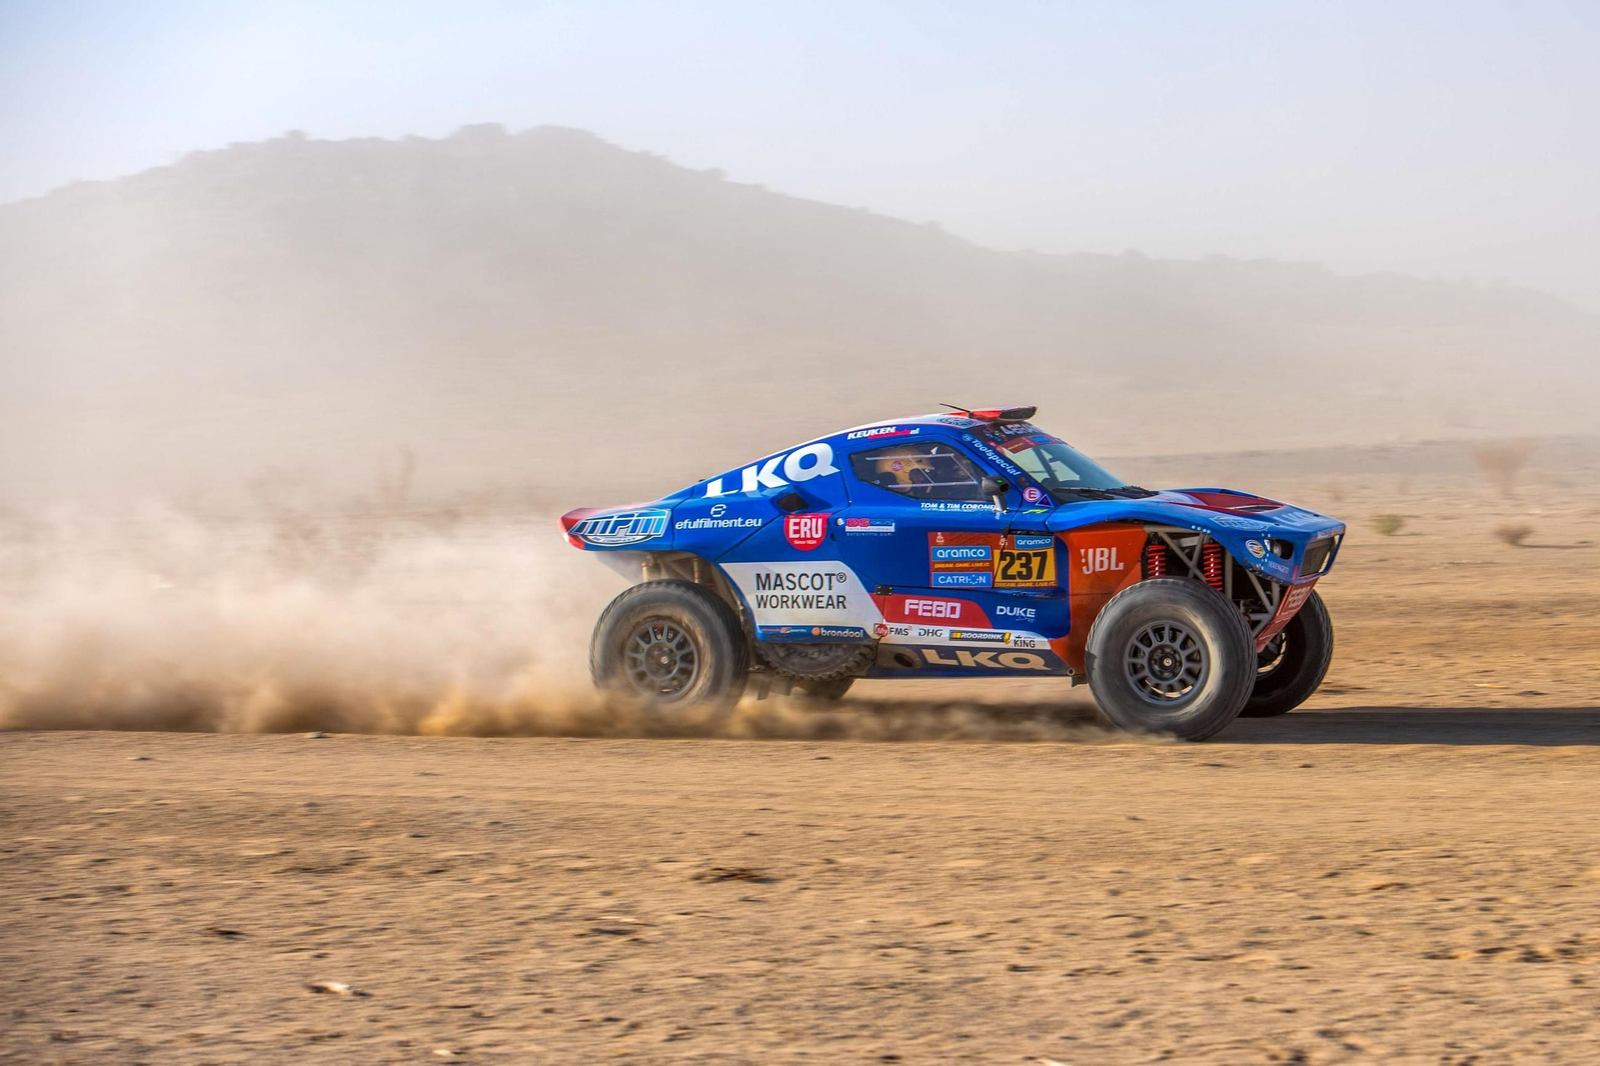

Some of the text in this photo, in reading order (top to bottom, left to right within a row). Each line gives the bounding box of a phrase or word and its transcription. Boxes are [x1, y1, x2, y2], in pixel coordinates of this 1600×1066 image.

[847, 426, 896, 440] KEUKEN
[701, 442, 841, 499] LKQ
[1027, 489, 1037, 499] E
[675, 516, 762, 530] efulfilment.eu
[788, 518, 823, 539] ERU
[1016, 538, 1052, 546] aramco
[936, 549, 986, 559] aramco
[1000, 551, 1048, 581] 237
[1081, 547, 1124, 575] JBL
[755, 594, 848, 610] WORKWEAR
[904, 599, 961, 618] FEBO
[996, 605, 1037, 618] DUKE
[820, 627, 864, 638] brondool
[889, 627, 909, 636] FMS
[918, 628, 944, 637] DHG
[961, 632, 1003, 640] ROORDINK
[1013, 640, 1036, 648] KING
[921, 649, 1052, 671] LKQ
